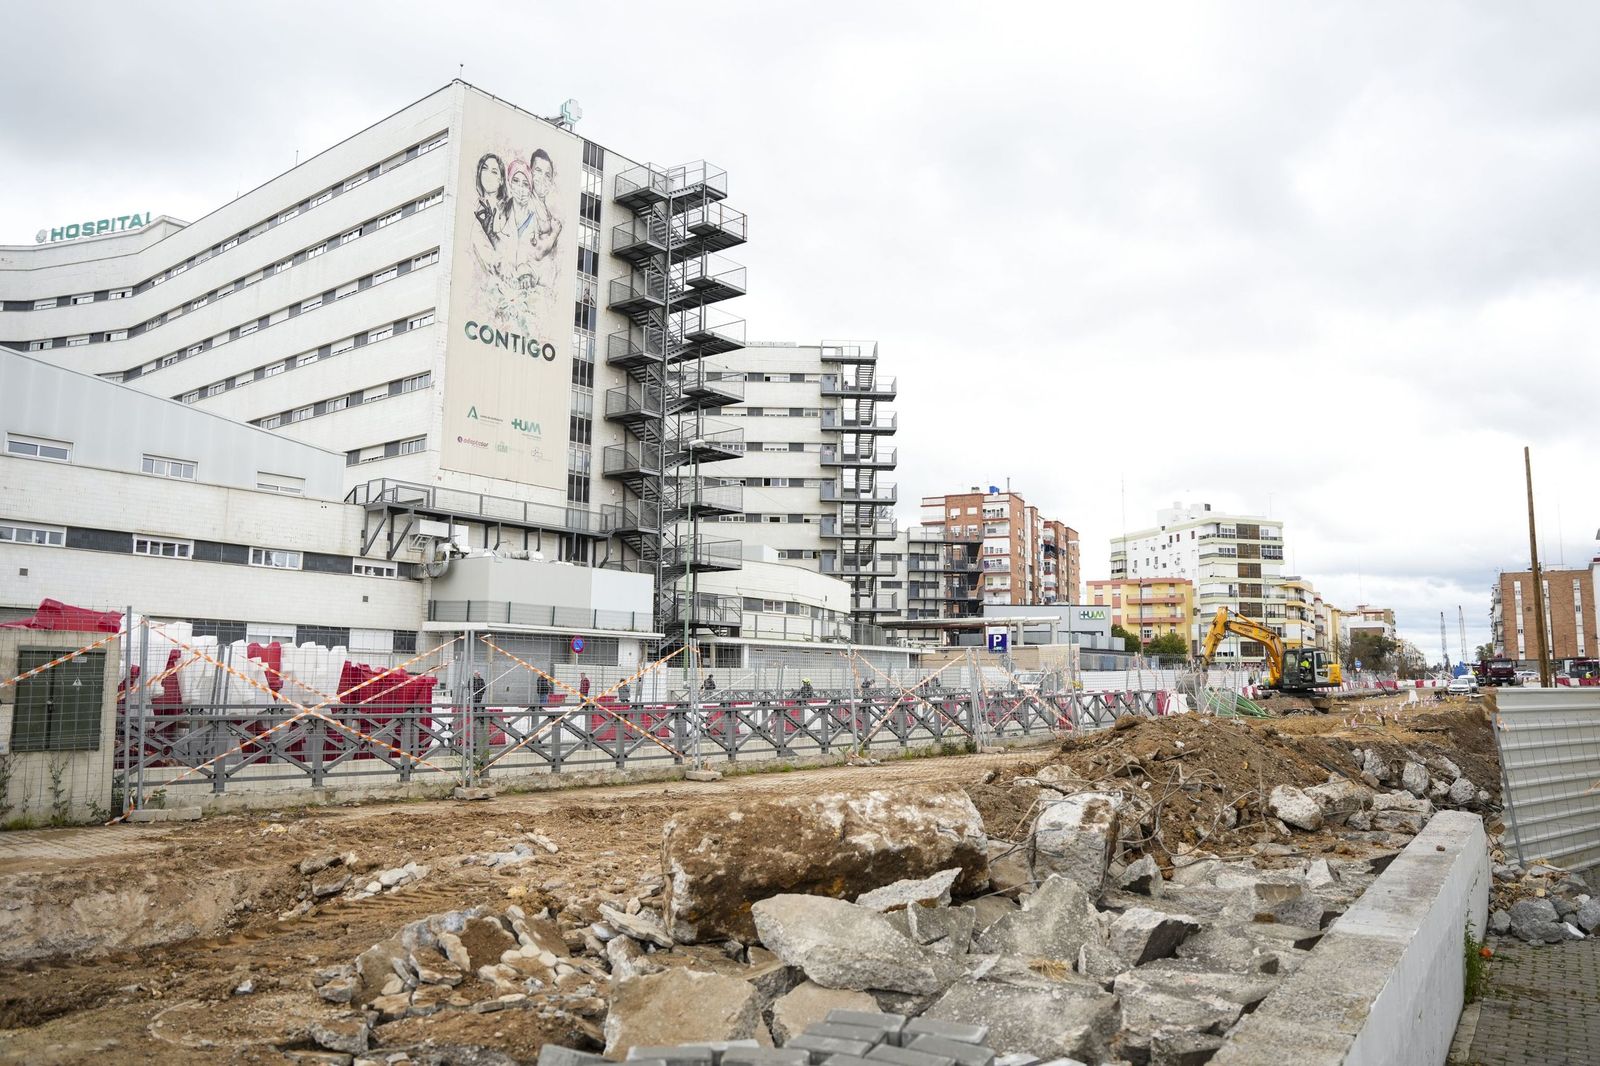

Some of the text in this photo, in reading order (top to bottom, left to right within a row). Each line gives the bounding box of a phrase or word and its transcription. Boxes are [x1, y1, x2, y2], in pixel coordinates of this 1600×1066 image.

[50, 211, 151, 242] HOSPITAL
[464, 320, 556, 362] CONTIGO
[993, 634, 1003, 647] P
